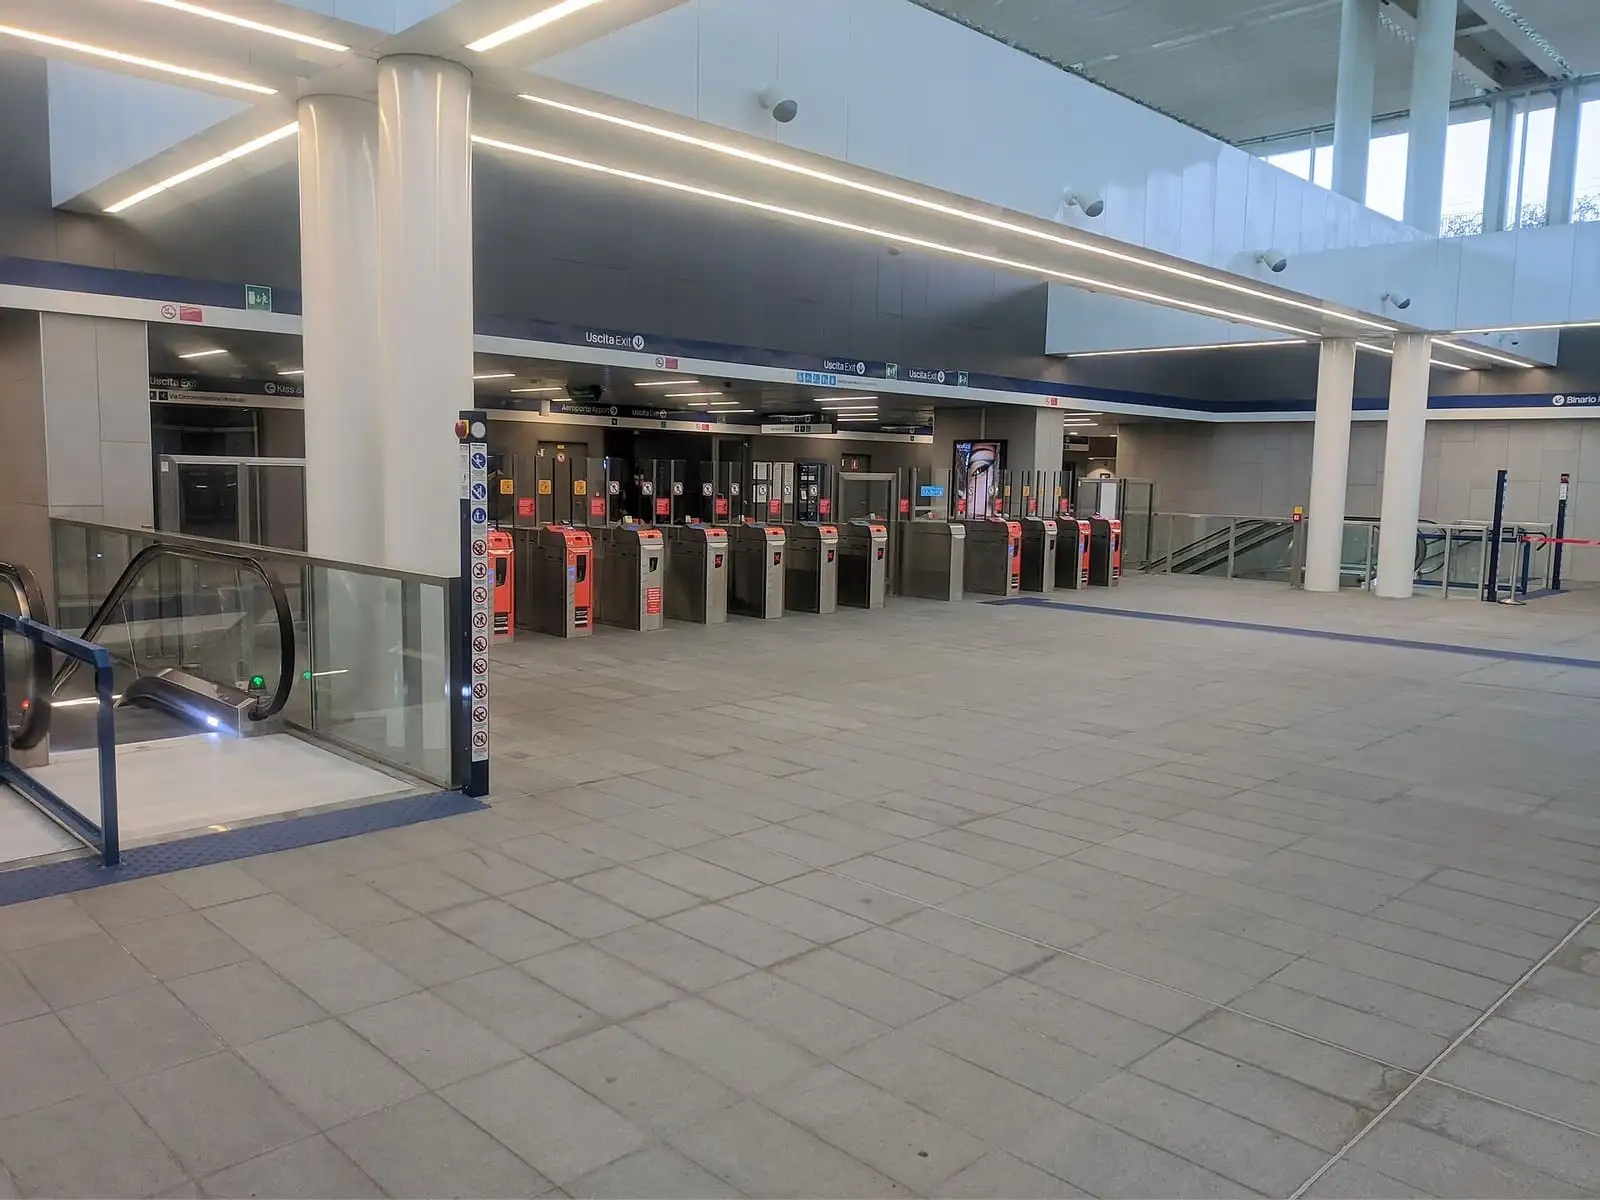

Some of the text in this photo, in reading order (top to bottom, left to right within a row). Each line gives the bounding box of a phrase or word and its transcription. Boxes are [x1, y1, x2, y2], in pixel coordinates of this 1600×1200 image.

[585, 332, 631, 347] Uscita Exit
[823, 360, 856, 372] Uscita Exit
[909, 369, 937, 380] Uscita Exit
[149, 376, 198, 388] Uscita Exit
[277, 384, 295, 393] Kiss
[1566, 396, 1597, 404] Binario
